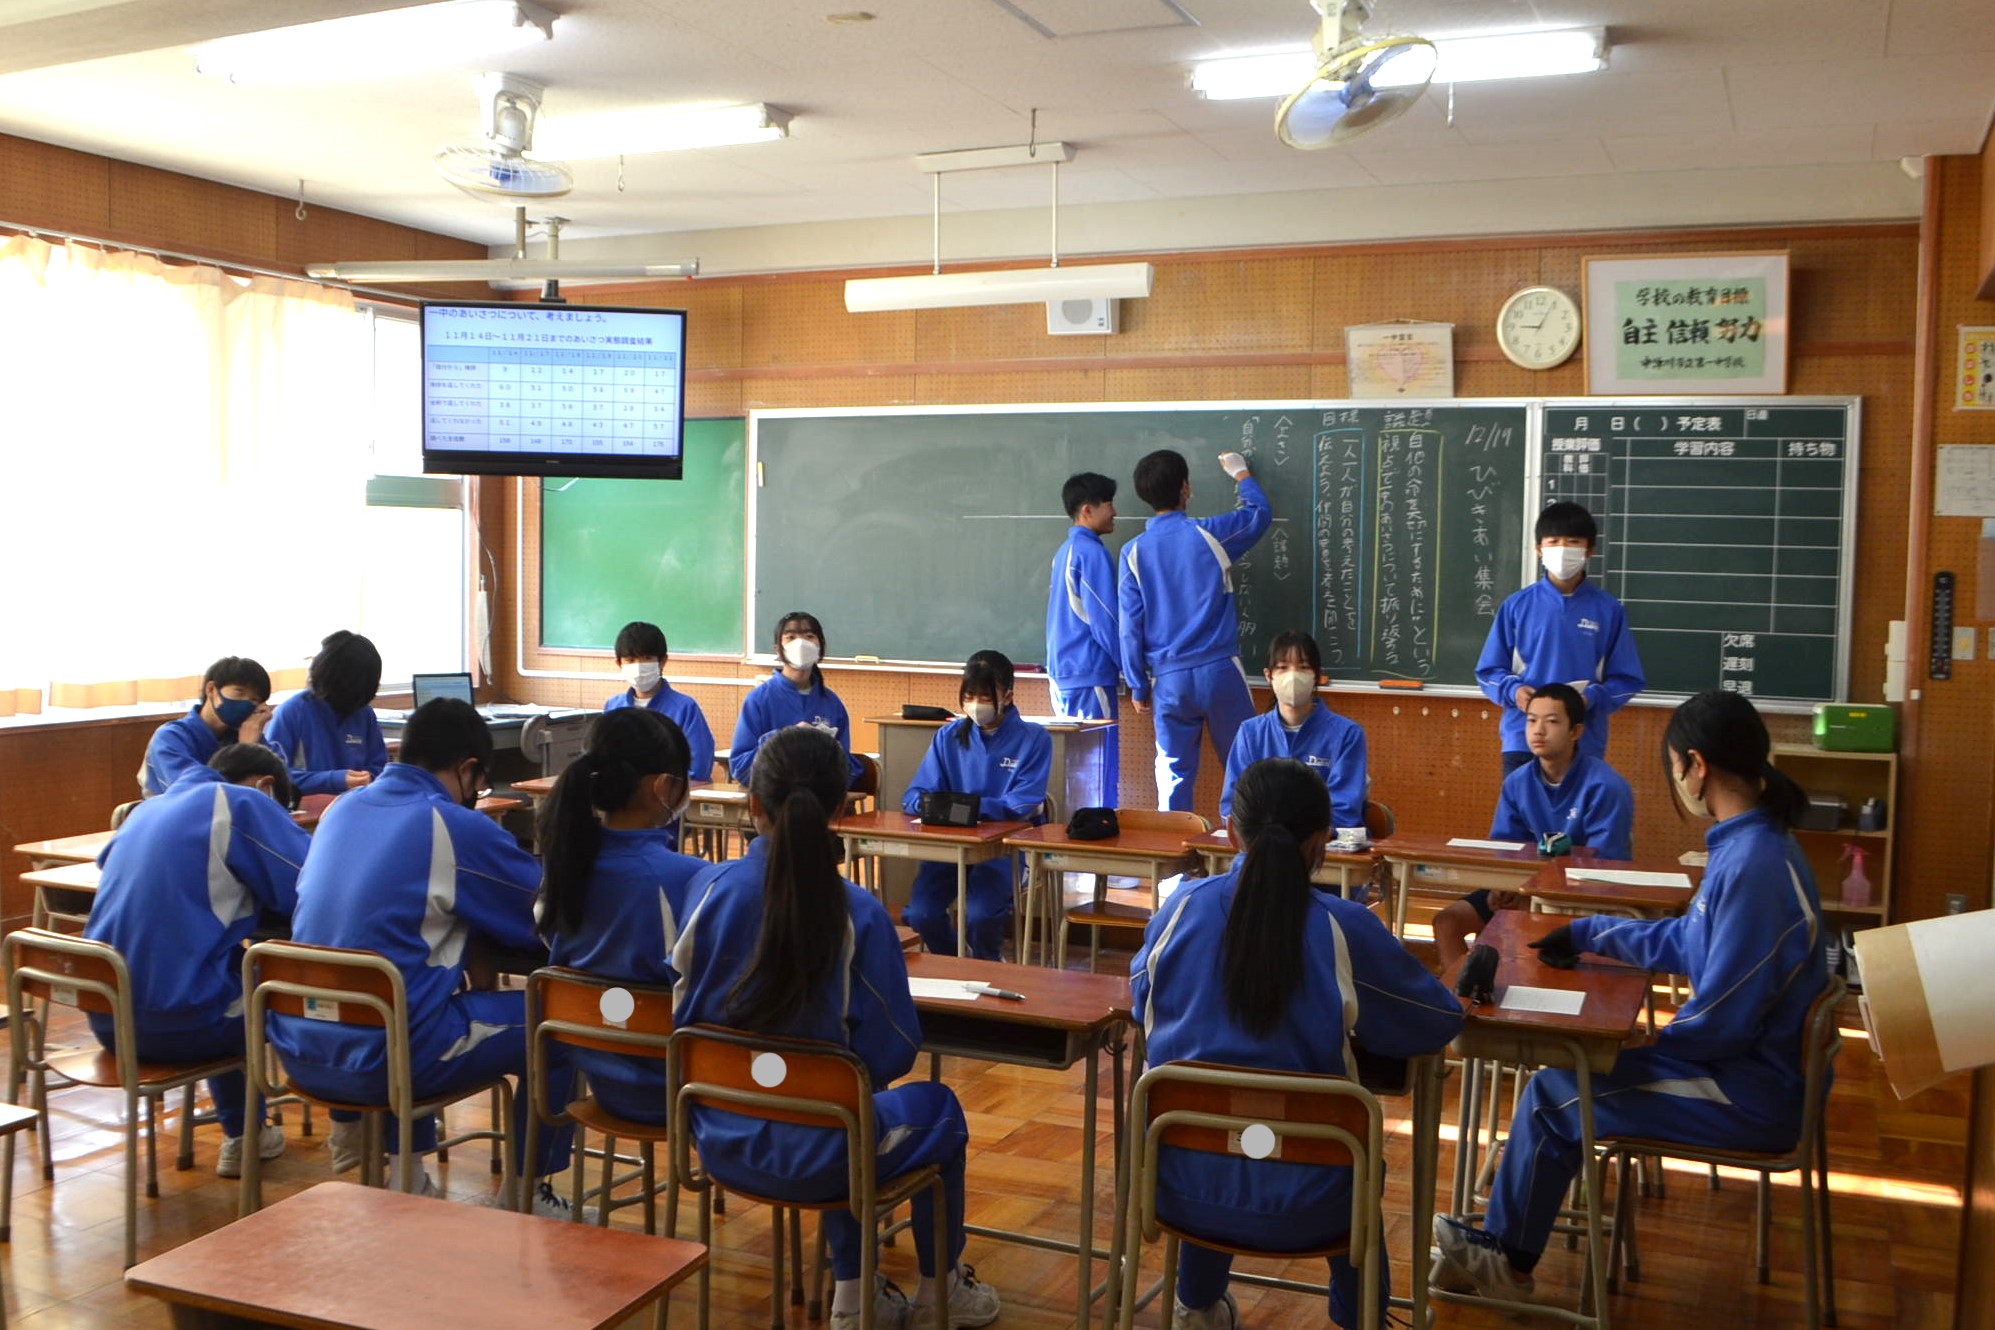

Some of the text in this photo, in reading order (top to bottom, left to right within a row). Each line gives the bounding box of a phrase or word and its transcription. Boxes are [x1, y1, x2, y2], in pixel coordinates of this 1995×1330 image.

[1636, 286, 1750, 306] 学校の教育目標
[1622, 316, 1762, 345] 自主 信頼 努力
[1523, 344, 1531, 353] 7
[1574, 416, 1589, 431] 月
[1673, 441, 1735, 456] 学習内容
[1788, 442, 1837, 457] 持ち物
[1547, 479, 1556, 490] 1
[1467, 464, 1500, 616] ひびきあい集会
[1723, 634, 1756, 648] 欠席
[1723, 657, 1755, 671] 遅刻
